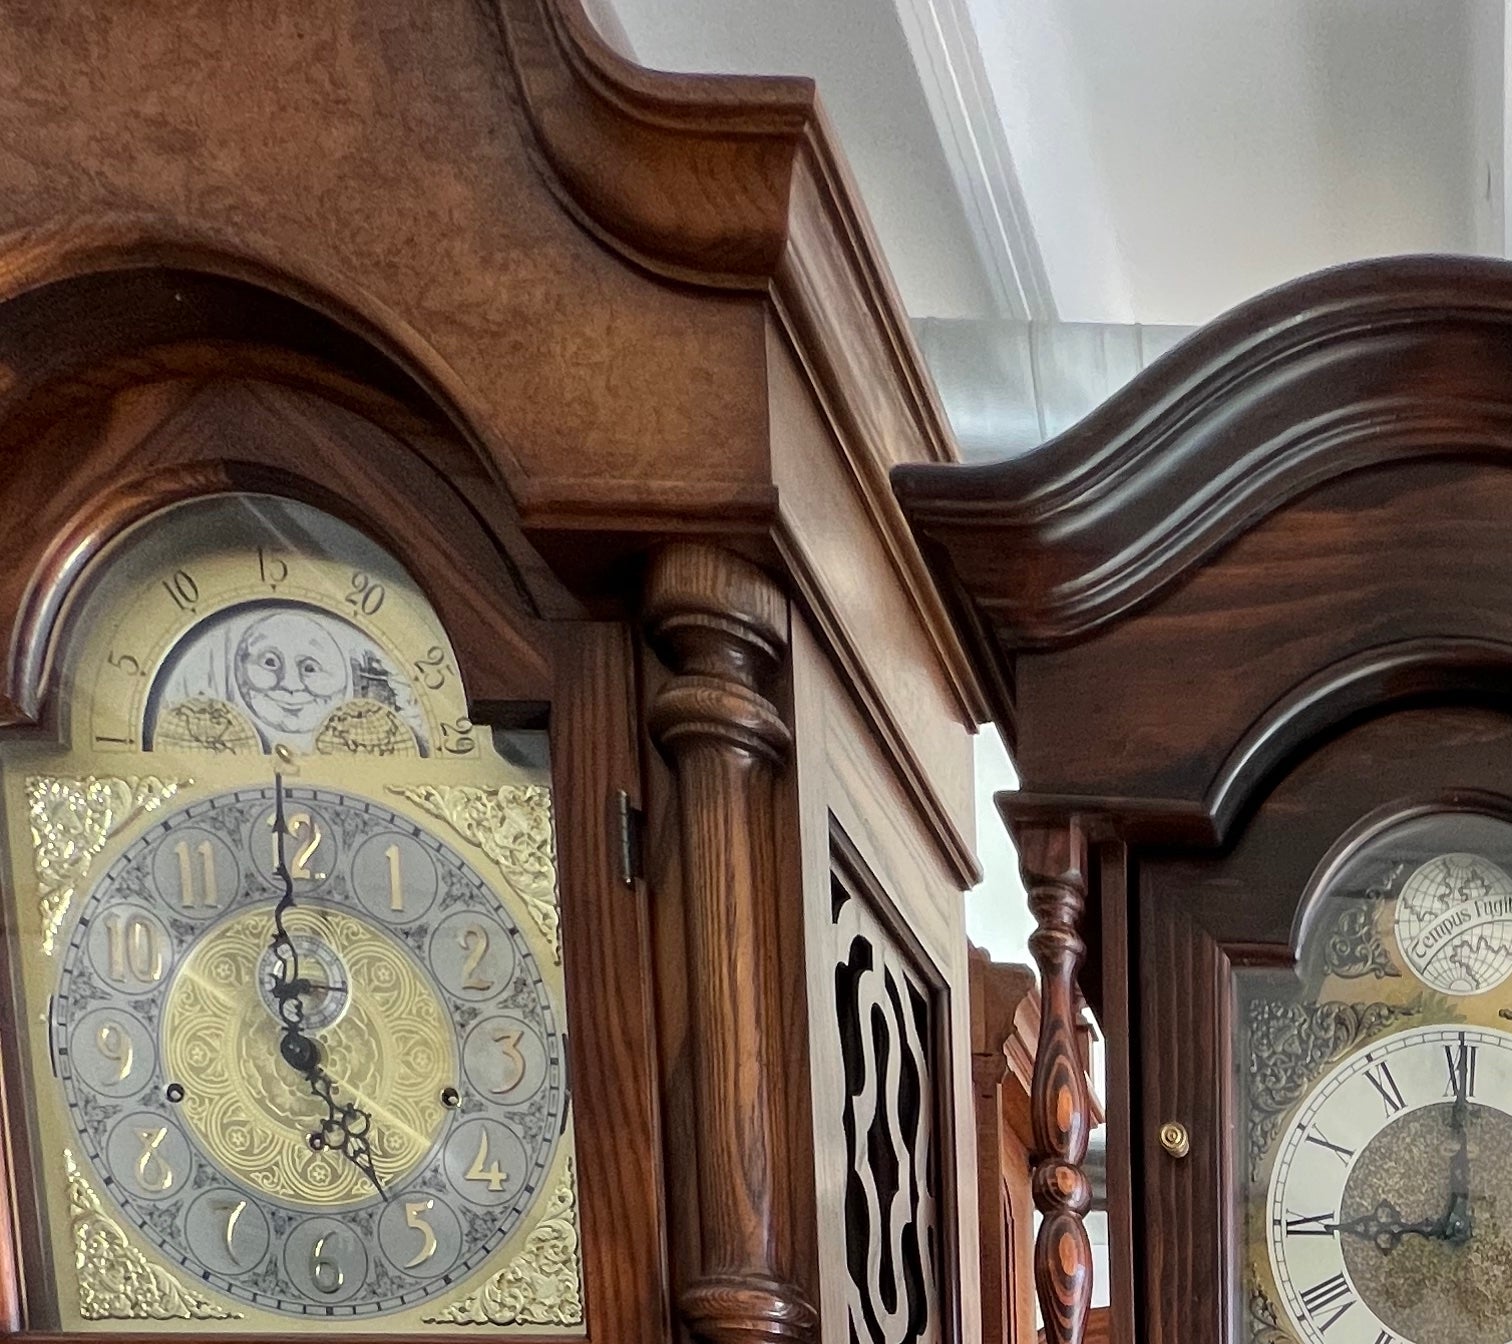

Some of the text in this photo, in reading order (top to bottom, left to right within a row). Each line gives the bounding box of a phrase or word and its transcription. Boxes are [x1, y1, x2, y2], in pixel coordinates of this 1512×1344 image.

[162, 568, 200, 612] 10
[257, 547, 288, 590] 15
[345, 570, 386, 616] 20
[107, 649, 140, 677] 5
[413, 645, 456, 690] 25
[441, 716, 476, 755] 29
[174, 839, 222, 909] 11
[266, 812, 326, 880] 12
[385, 843, 404, 912] 1
[104, 912, 163, 984] 10
[459, 923, 495, 990] 2
[1411, 908, 1471, 959] Tempus
[96, 1020, 133, 1087] 9
[490, 1030, 526, 1095] 3
[1442, 1045, 1478, 1099] XII
[1363, 1062, 1408, 1118] XI
[135, 1125, 173, 1193] 8
[464, 1125, 508, 1192] 4
[1305, 1124, 1356, 1162] X
[210, 1200, 248, 1268] 7
[404, 1198, 438, 1269] 5
[1285, 1208, 1337, 1237] IX
[311, 1230, 344, 1295] 6
[1299, 1273, 1357, 1334] VIII
